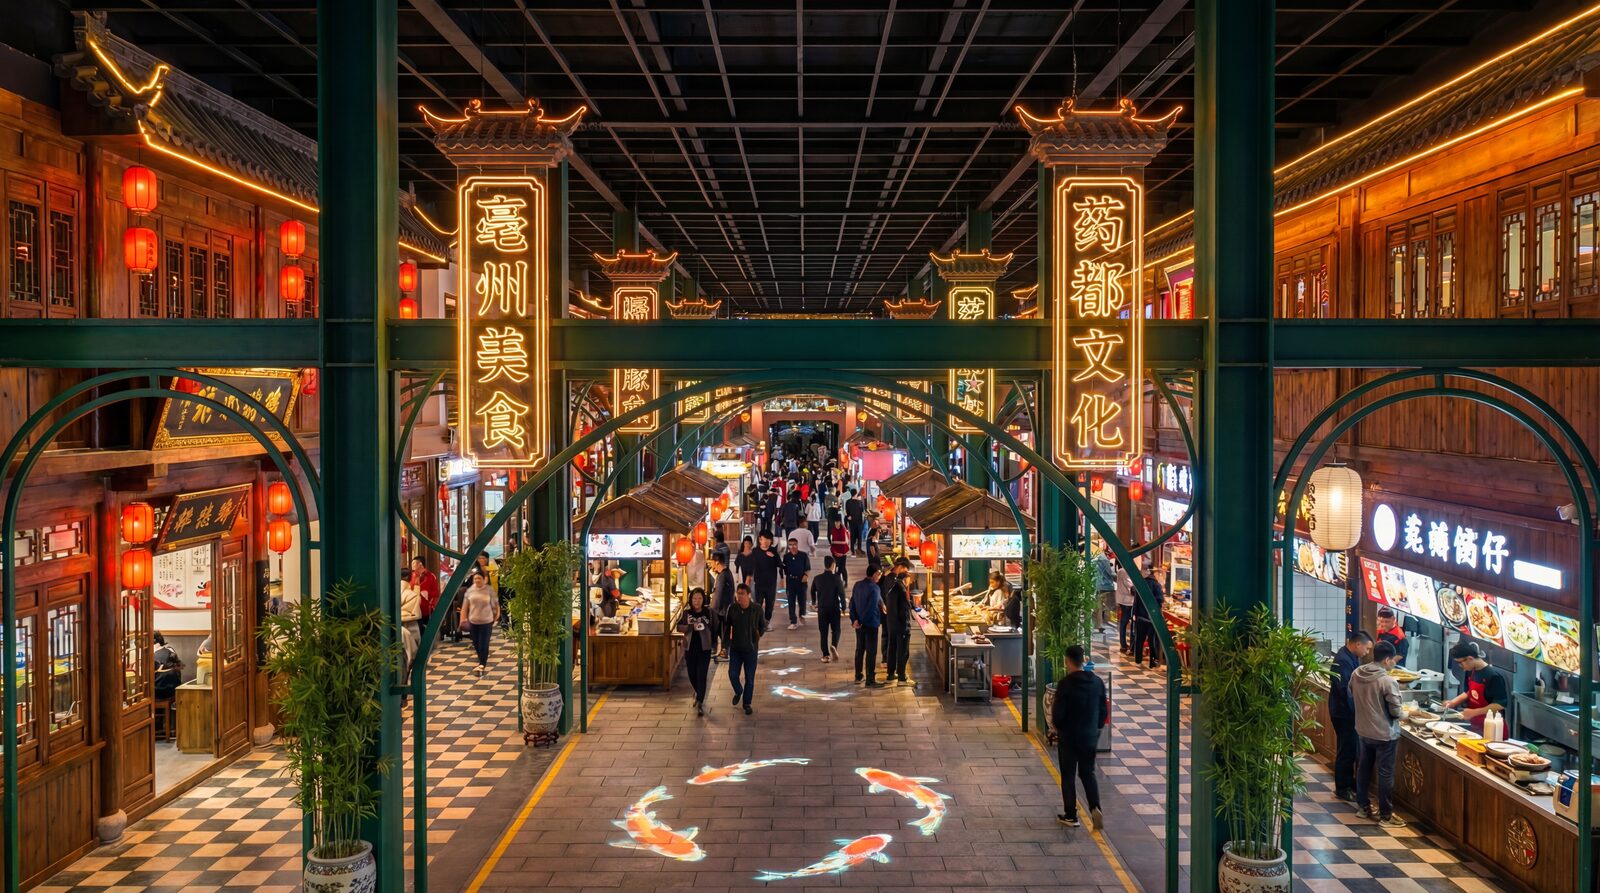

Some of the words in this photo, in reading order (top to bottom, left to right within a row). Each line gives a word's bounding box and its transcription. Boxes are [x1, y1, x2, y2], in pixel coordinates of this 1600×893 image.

[475, 195, 529, 449] 亳州美食
[1070, 195, 1125, 448] 药都文化
